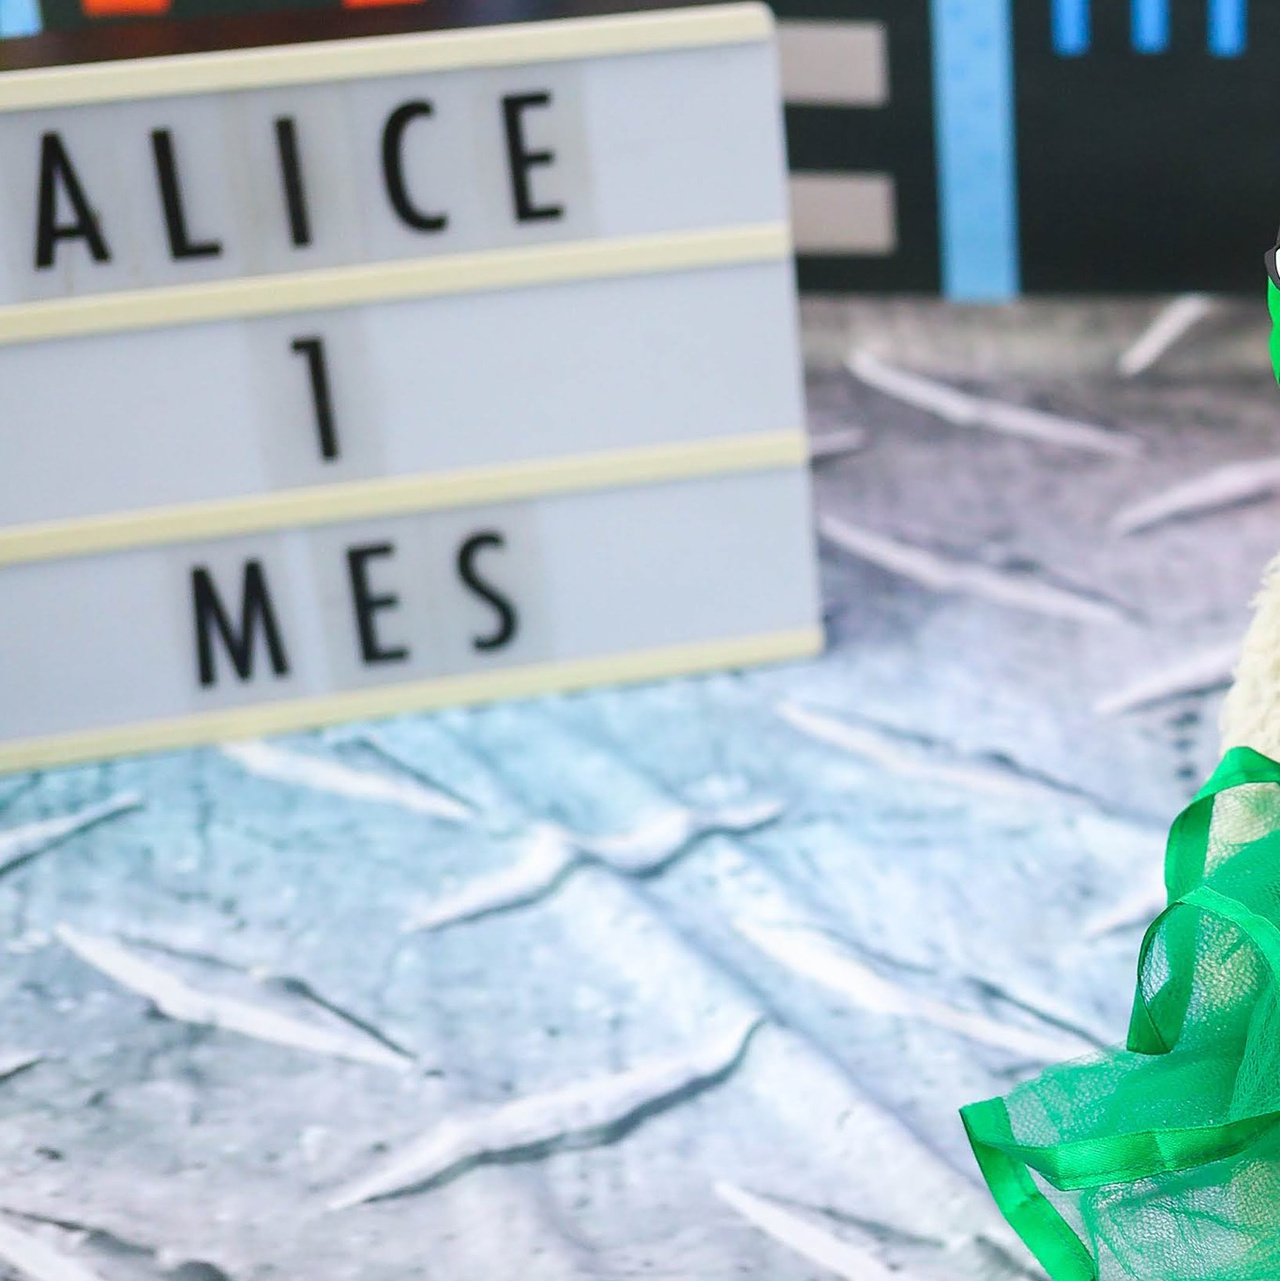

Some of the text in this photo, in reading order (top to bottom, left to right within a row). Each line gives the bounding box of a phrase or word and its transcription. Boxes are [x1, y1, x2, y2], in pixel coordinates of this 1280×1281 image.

[33, 90, 565, 271] ALICE
[291, 336, 340, 462] 1
[189, 531, 519, 689] MES
